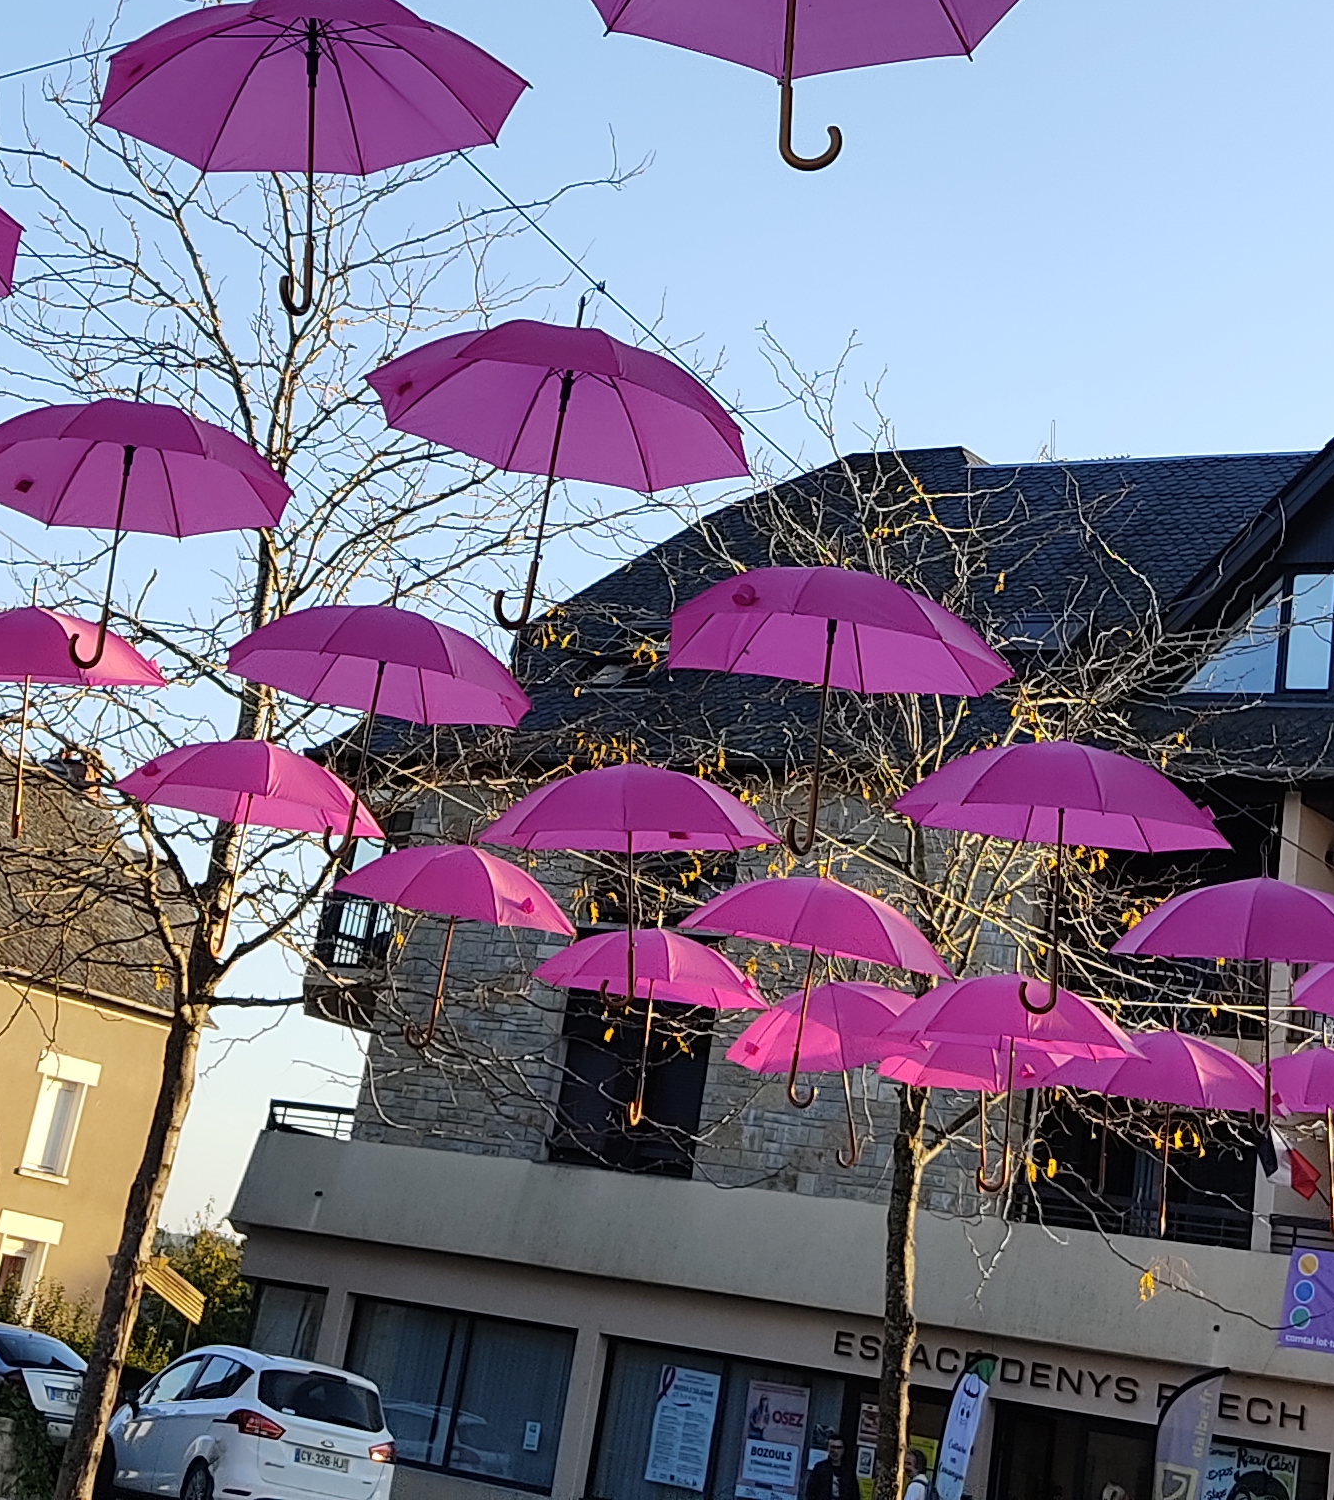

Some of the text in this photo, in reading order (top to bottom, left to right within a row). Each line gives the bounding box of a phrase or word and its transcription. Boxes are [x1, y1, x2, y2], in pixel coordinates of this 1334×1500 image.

[999, 1356, 1140, 1405] DENYS
[1156, 1382, 1307, 1431] PECH
[772, 1410, 804, 1428] OSEZ
[1192, 1388, 1213, 1458] dalbe.fr
[750, 1446, 793, 1462] BOZOULS
